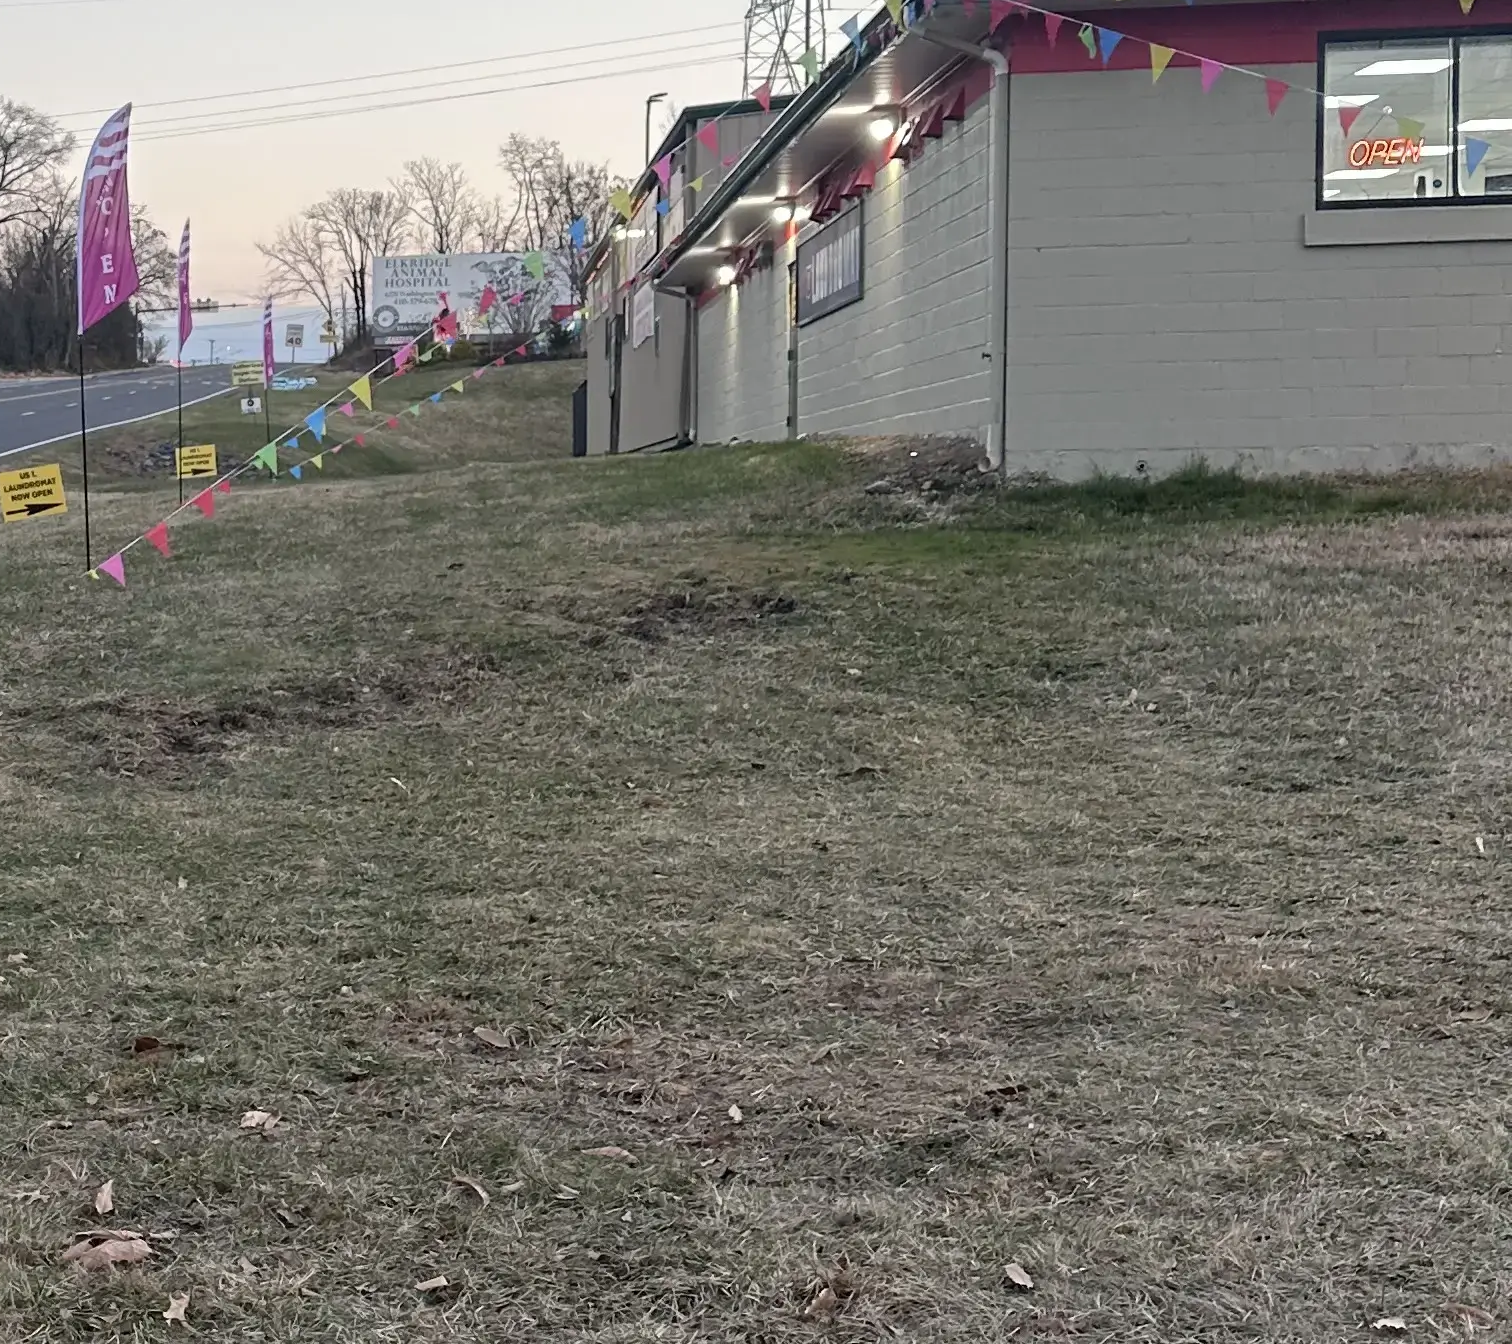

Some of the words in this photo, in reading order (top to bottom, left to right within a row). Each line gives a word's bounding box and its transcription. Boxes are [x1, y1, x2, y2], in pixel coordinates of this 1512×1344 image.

[1350, 137, 1425, 167] OPEN
[391, 268, 445, 277] ANIMAL
[385, 277, 451, 288] HOSPITAL
[287, 337, 302, 345] 40
[3, 477, 56, 493] LAUNDROMAT
[11, 492, 31, 502] NOW
[32, 489, 53, 498] OPEN
